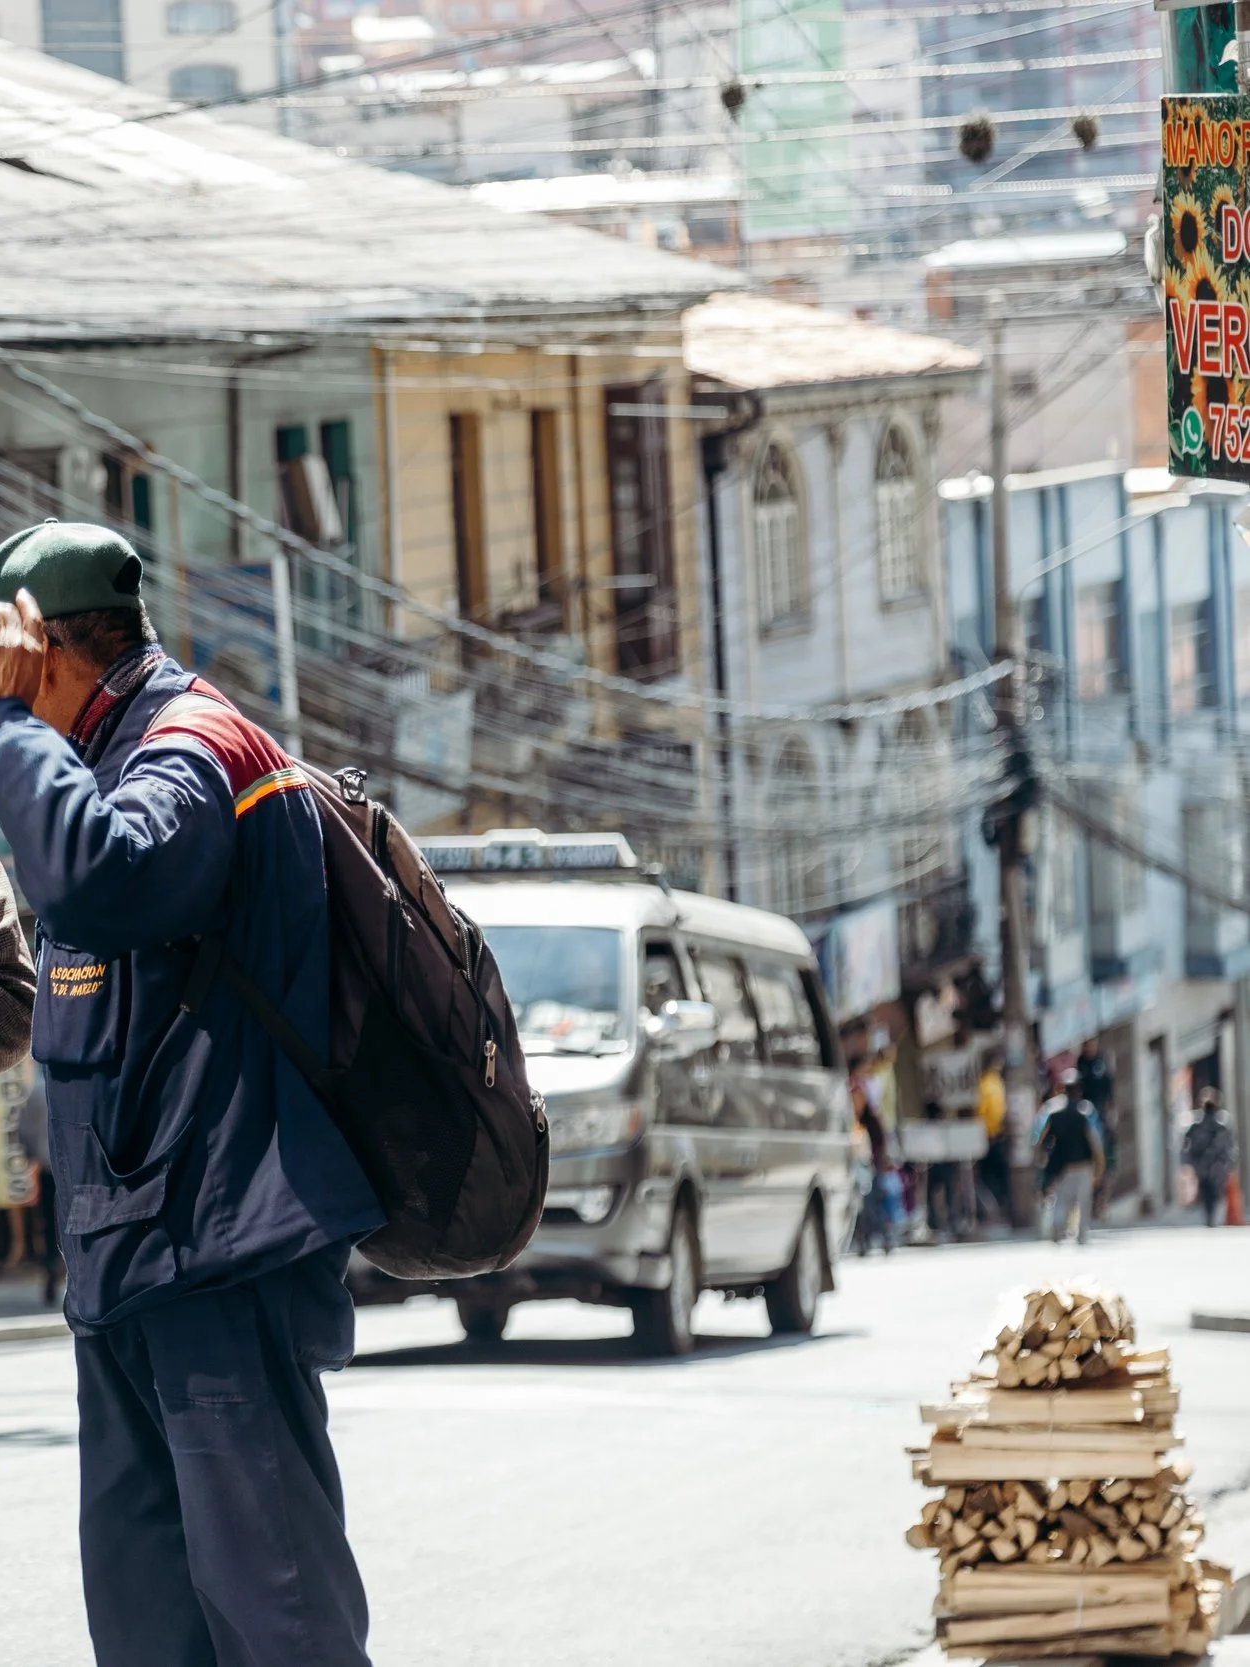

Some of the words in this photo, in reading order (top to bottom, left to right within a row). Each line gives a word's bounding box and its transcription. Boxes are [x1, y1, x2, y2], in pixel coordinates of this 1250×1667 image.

[1165, 120, 1235, 168] MANO
[1170, 299, 1250, 380] VER
[50, 964, 106, 981] ASOCIACION
